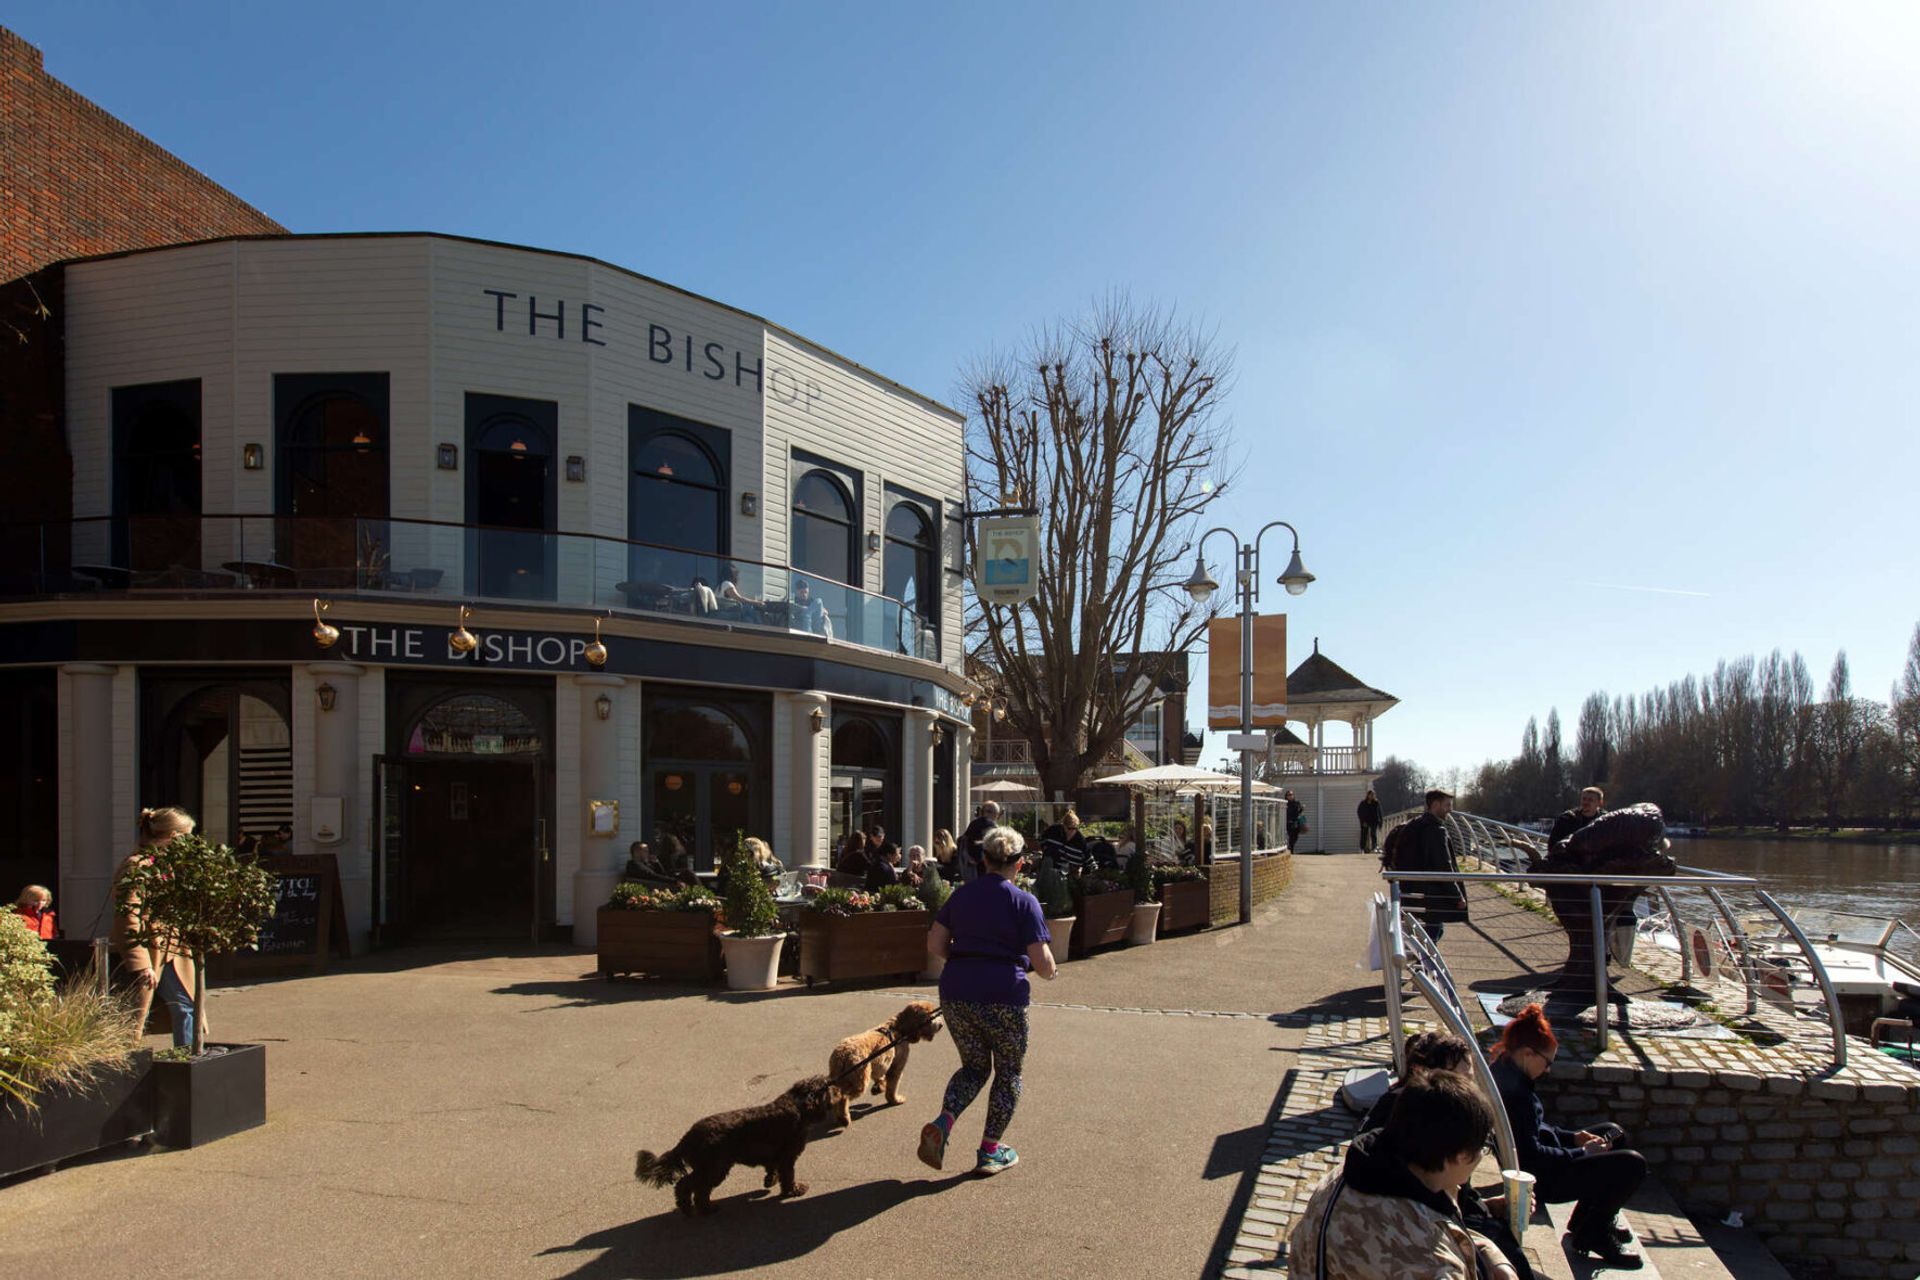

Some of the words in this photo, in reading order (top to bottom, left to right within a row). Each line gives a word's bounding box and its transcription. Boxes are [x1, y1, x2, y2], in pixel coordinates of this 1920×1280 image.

[484, 289, 606, 347] THE
[648, 323, 821, 414] BISHOP
[342, 626, 424, 658] THE
